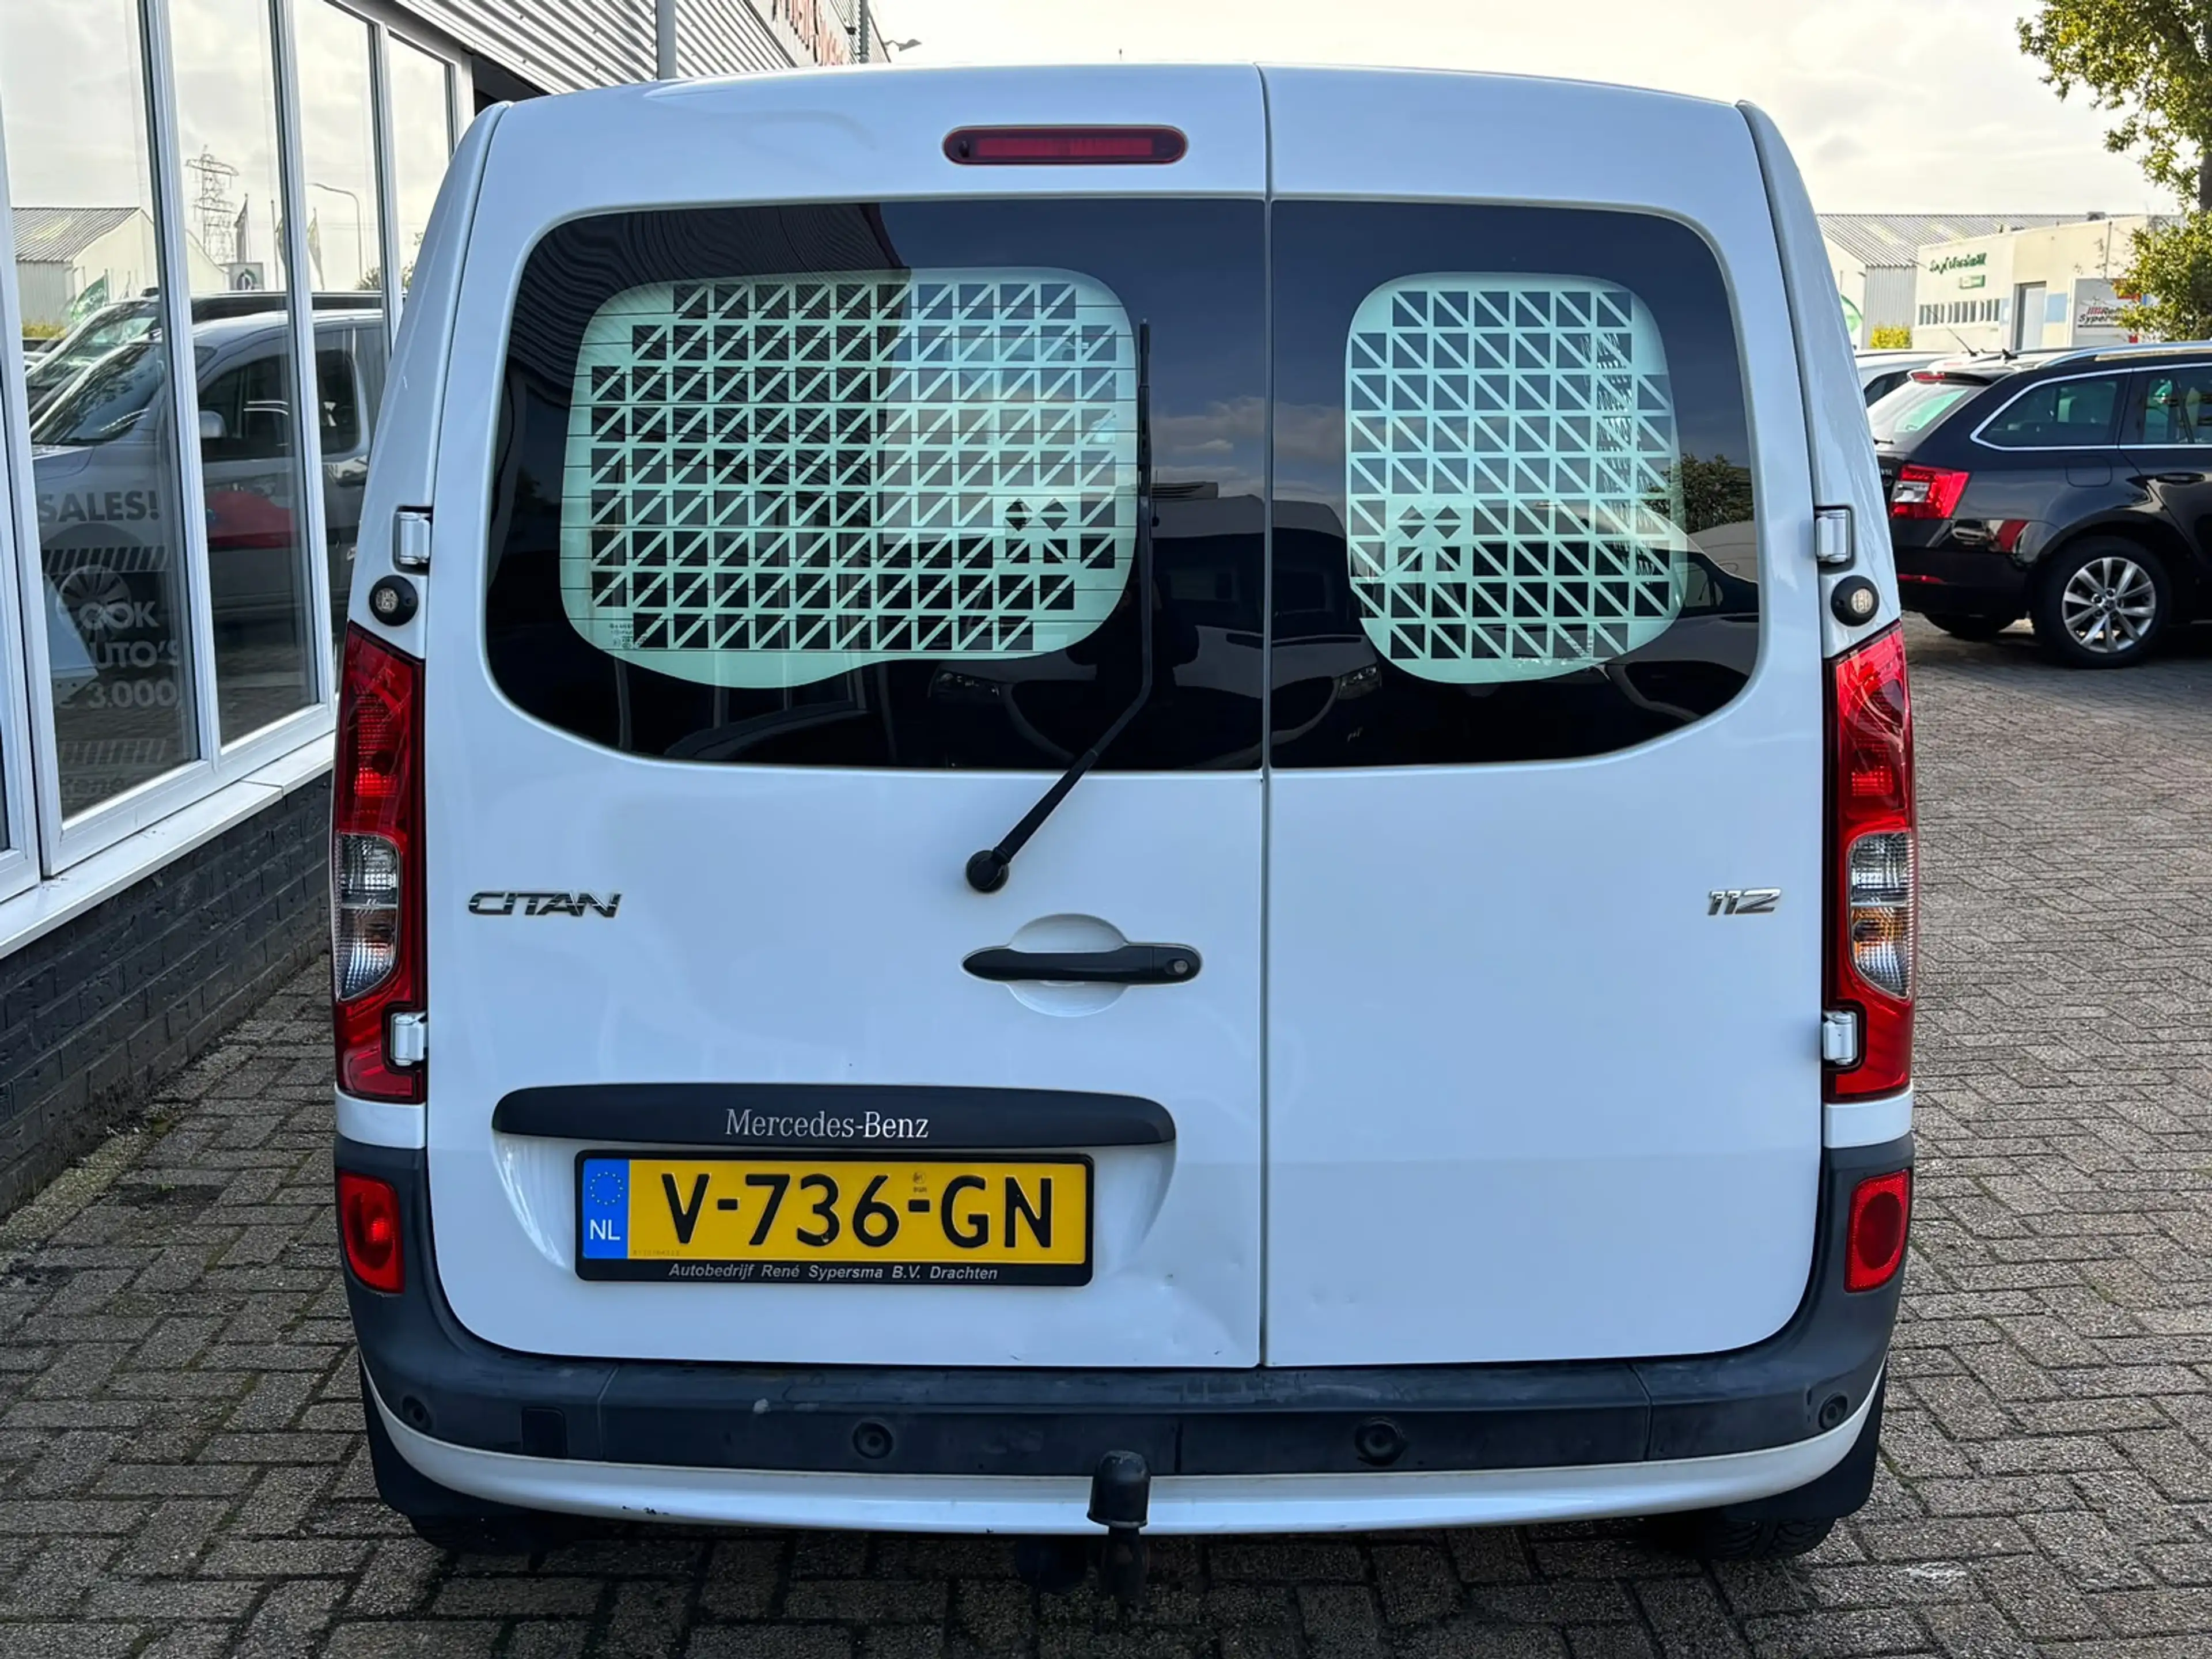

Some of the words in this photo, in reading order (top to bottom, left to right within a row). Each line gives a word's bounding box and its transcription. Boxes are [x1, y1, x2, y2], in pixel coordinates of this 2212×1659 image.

[36, 490, 160, 522] SALES!
[88, 640, 180, 670] UTO'S
[468, 891, 622, 918] CITAN
[1707, 887, 1782, 915] 112
[724, 1108, 929, 1138] Mercedes-Benz
[661, 1173, 1053, 1249] V-736-GN
[589, 1219, 620, 1241] NL
[668, 1263, 755, 1279] Autobedrijf
[761, 1264, 800, 1278] René
[808, 1264, 883, 1281] Sypersma
[892, 1265, 921, 1279] B.V.
[930, 1266, 998, 1280] Drachten
